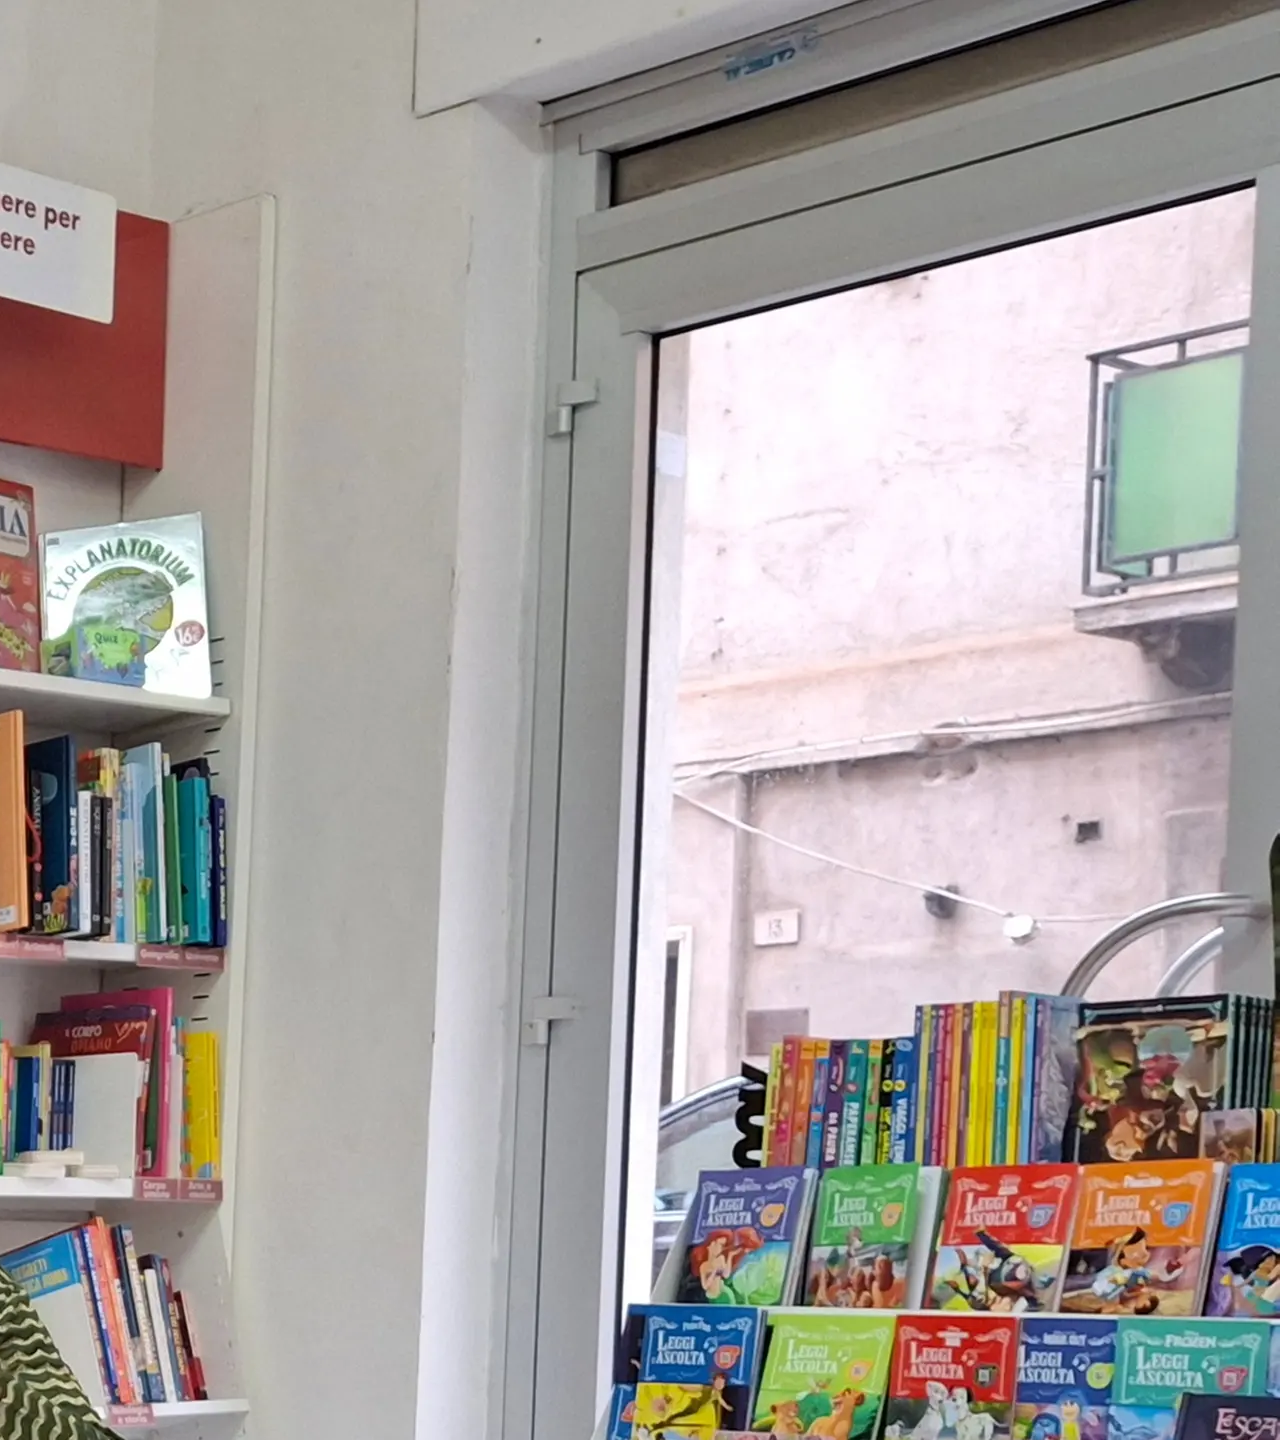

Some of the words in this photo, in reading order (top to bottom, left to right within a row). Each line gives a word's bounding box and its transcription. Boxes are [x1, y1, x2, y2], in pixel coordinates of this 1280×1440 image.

[44, 203, 81, 236] per
[46, 537, 195, 602] EXPLANATORIUM
[709, 1194, 744, 1212] LEGGI
[834, 1194, 867, 1212] LEGGI
[965, 1192, 1008, 1213] LEGGI
[1096, 1190, 1141, 1212] LEGGI
[707, 1212, 753, 1226] ASCOLTA
[833, 1211, 875, 1226] ASCOLTA
[963, 1210, 1017, 1226] ASCOLTA
[1095, 1210, 1151, 1226] ASCOLTA
[656, 1331, 696, 1351] LEGGI
[787, 1340, 829, 1359] LEGGI
[655, 1349, 707, 1366] ASCOLTA
[909, 1341, 953, 1363] LEGGI
[1017, 1345, 1063, 1368] LEGGI
[1136, 1345, 1190, 1369] LEGGI
[783, 1358, 839, 1375] ASCOLTA
[909, 1362, 965, 1380] ASCOLTA
[1017, 1365, 1075, 1385] ASCOLTA
[1136, 1367, 1204, 1388] ASCOLTA
